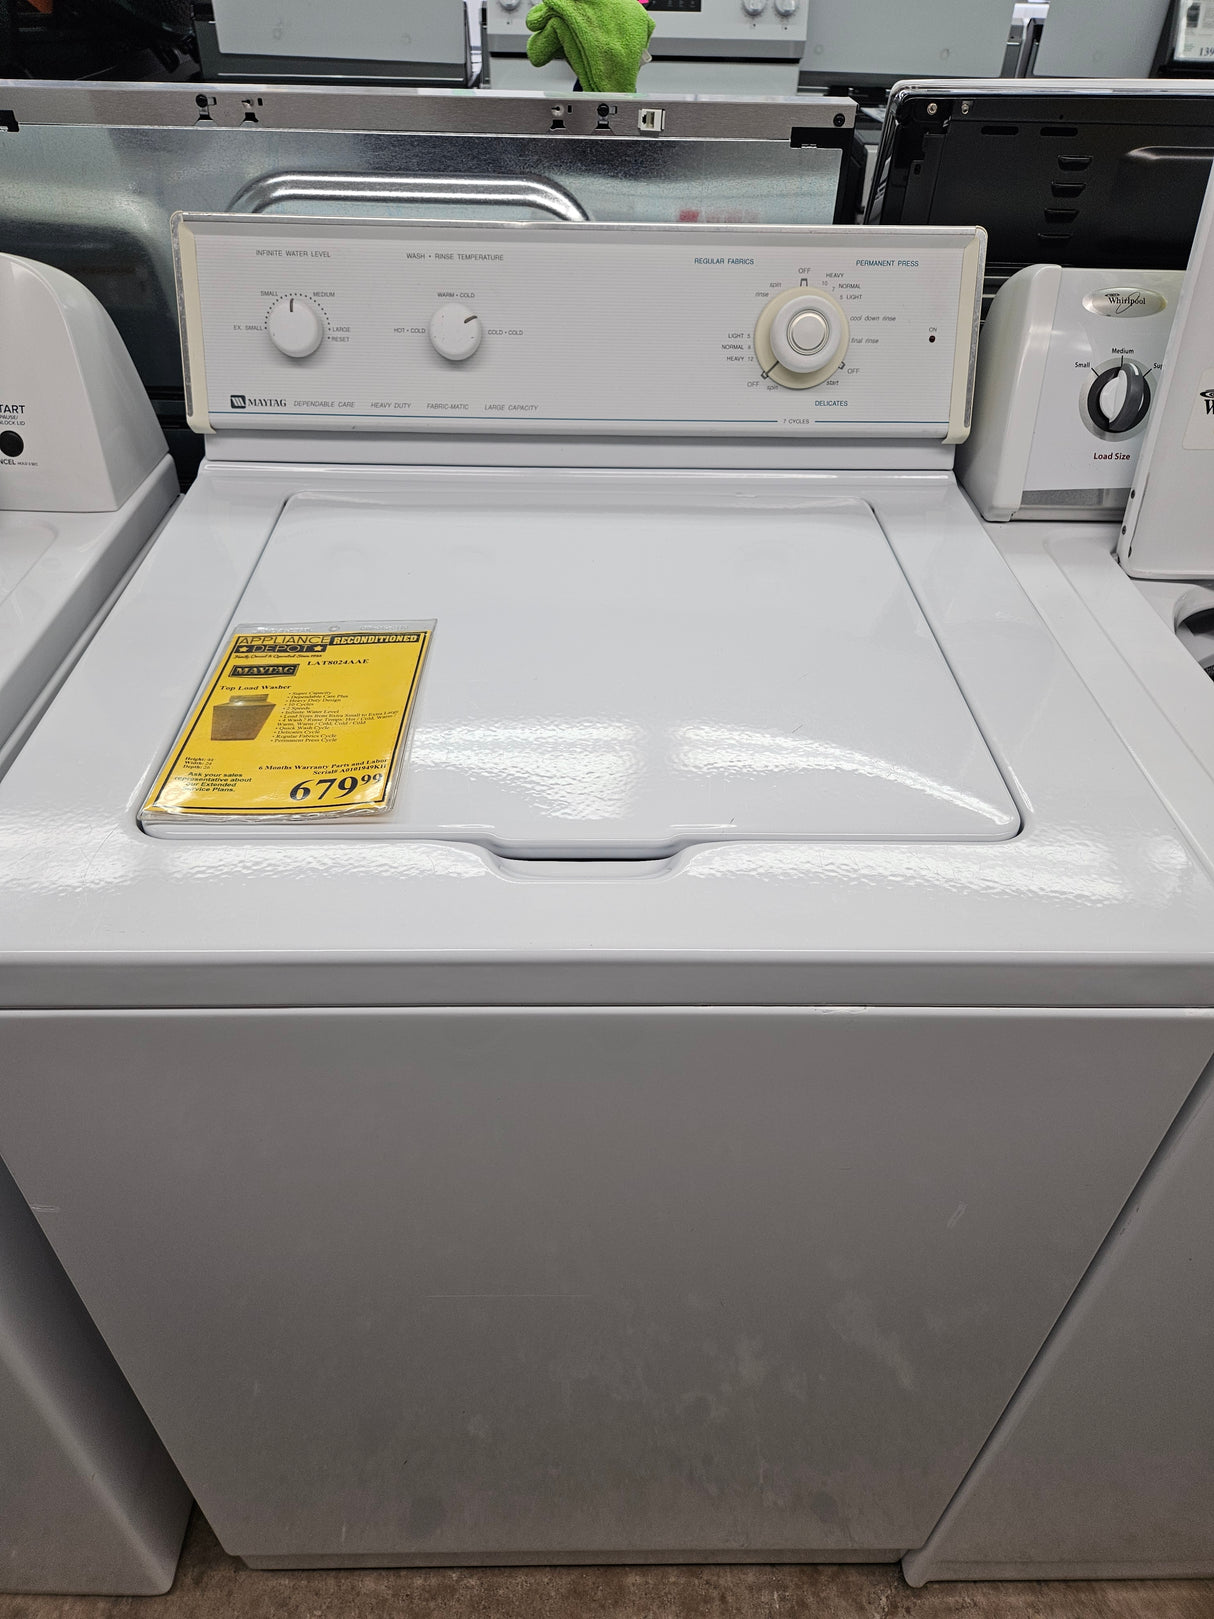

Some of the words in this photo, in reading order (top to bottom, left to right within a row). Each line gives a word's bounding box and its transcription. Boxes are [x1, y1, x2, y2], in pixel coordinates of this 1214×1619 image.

[457, 253, 504, 261] TEMPERATURE
[694, 257, 725, 265] REGULAR
[1108, 296, 1146, 306] Whirlpool
[247, 398, 287, 407] MAYTAG
[293, 400, 334, 408] DEPENDABLE
[1093, 452, 1113, 460] Load
[1114, 453, 1131, 461] Size
[238, 635, 330, 644] APPLIANCE
[333, 635, 418, 645] RECONDITIONED
[252, 645, 309, 653] DEPOT
[236, 666, 294, 674] MAYTAG
[289, 776, 359, 801] 679
[360, 773, 383, 786] 99
